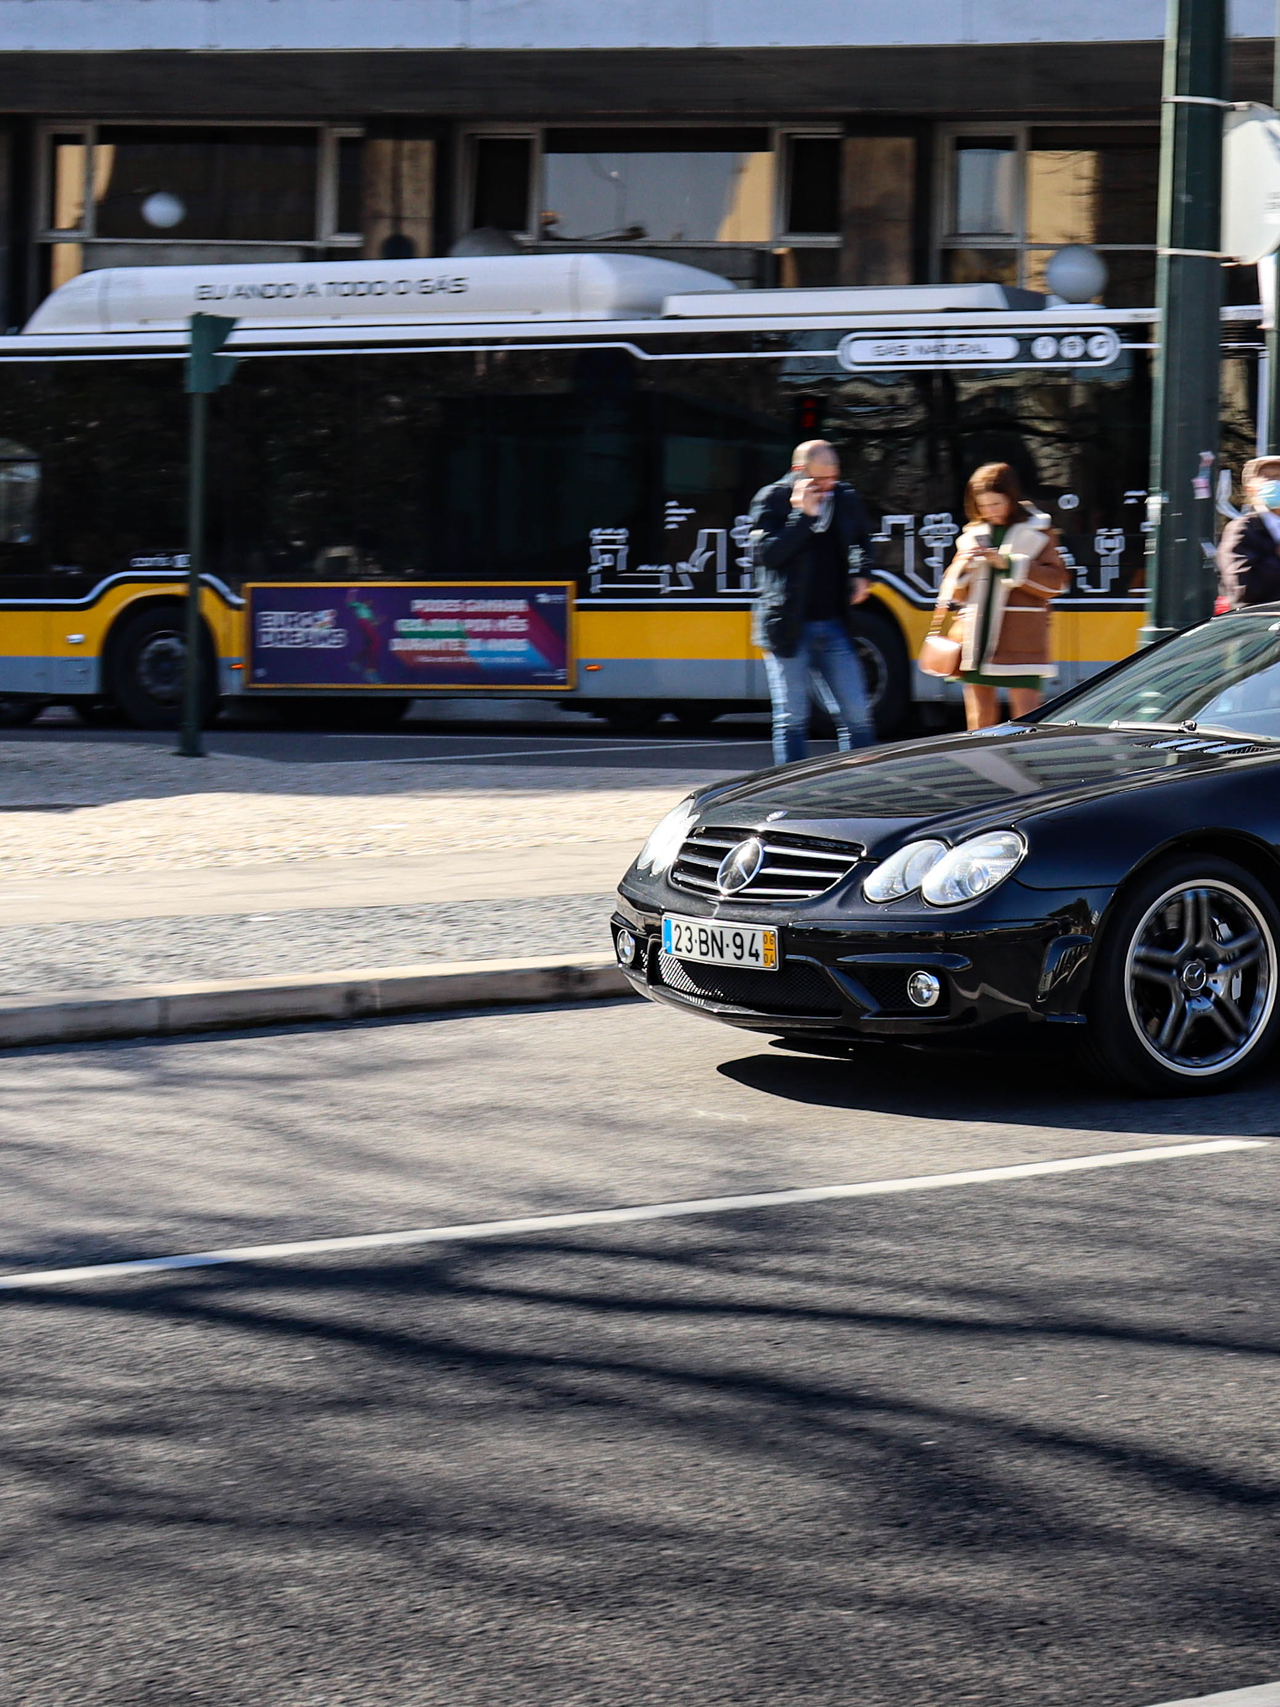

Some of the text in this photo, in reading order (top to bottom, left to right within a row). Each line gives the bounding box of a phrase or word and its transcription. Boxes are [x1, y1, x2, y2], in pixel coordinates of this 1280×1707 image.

[195, 274, 470, 301] EU ANDO A TODO O GÁS
